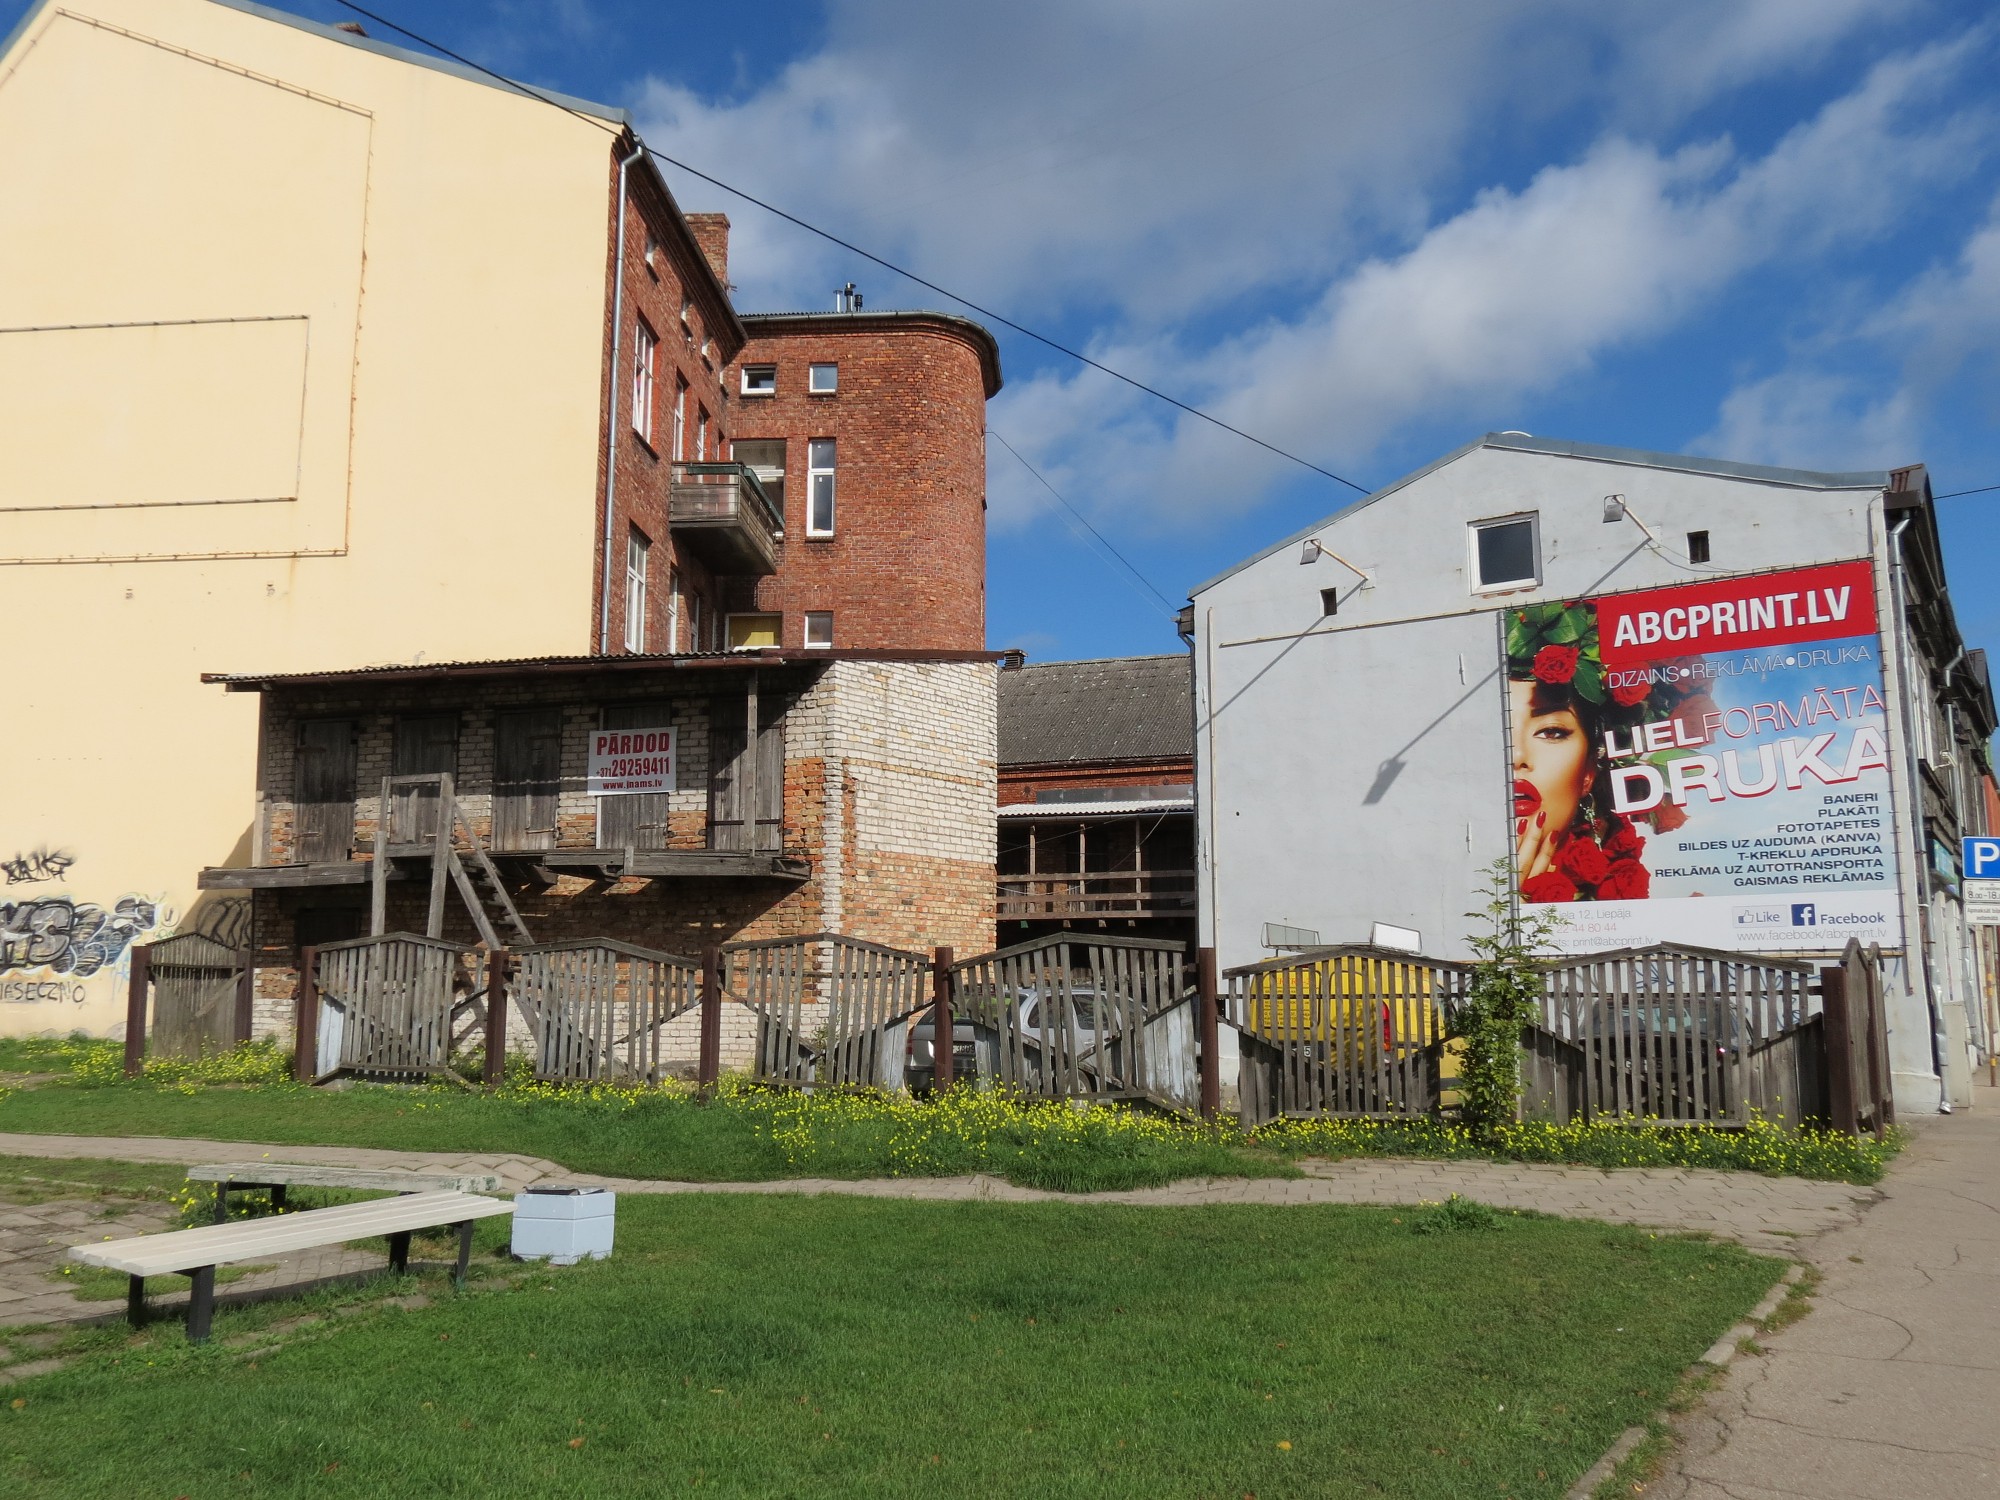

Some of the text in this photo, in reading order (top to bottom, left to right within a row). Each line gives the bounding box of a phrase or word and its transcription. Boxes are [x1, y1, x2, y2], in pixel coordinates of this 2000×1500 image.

[1613, 585, 1851, 648] ABCPRINT.LV
[596, 732, 670, 756] PĀRDOD
[1610, 725, 1889, 817] DRUKA
[1823, 793, 1879, 805] BANERI
[1818, 805, 1879, 818] PLAKĀTI
[1777, 819, 1881, 834] FOTOTAPETES
[1678, 832, 1882, 852] BILDES UZ AUDUMA (KANVA)
[1738, 845, 1883, 861] T-KREKLU APDRUKA
[1973, 841, 2000, 875] P
[1655, 858, 1884, 878] REKLĀMA UZ AUTOTRANSPORTA
[1733, 871, 1885, 887] GAISMAS REKLĀMAS
[1596, 907, 1632, 920] Liepāja
[1755, 911, 1781, 923] Like
[1820, 912, 1886, 925] Facebook
[1556, 924, 1569, 934] 22
[1572, 923, 1585, 933] 44
[1587, 923, 1601, 933] 80
[1603, 923, 1617, 932] 44
[1736, 928, 1887, 941] www.facebook/abcprint.lv
[1572, 937, 1654, 949] print@abcprint.lv
